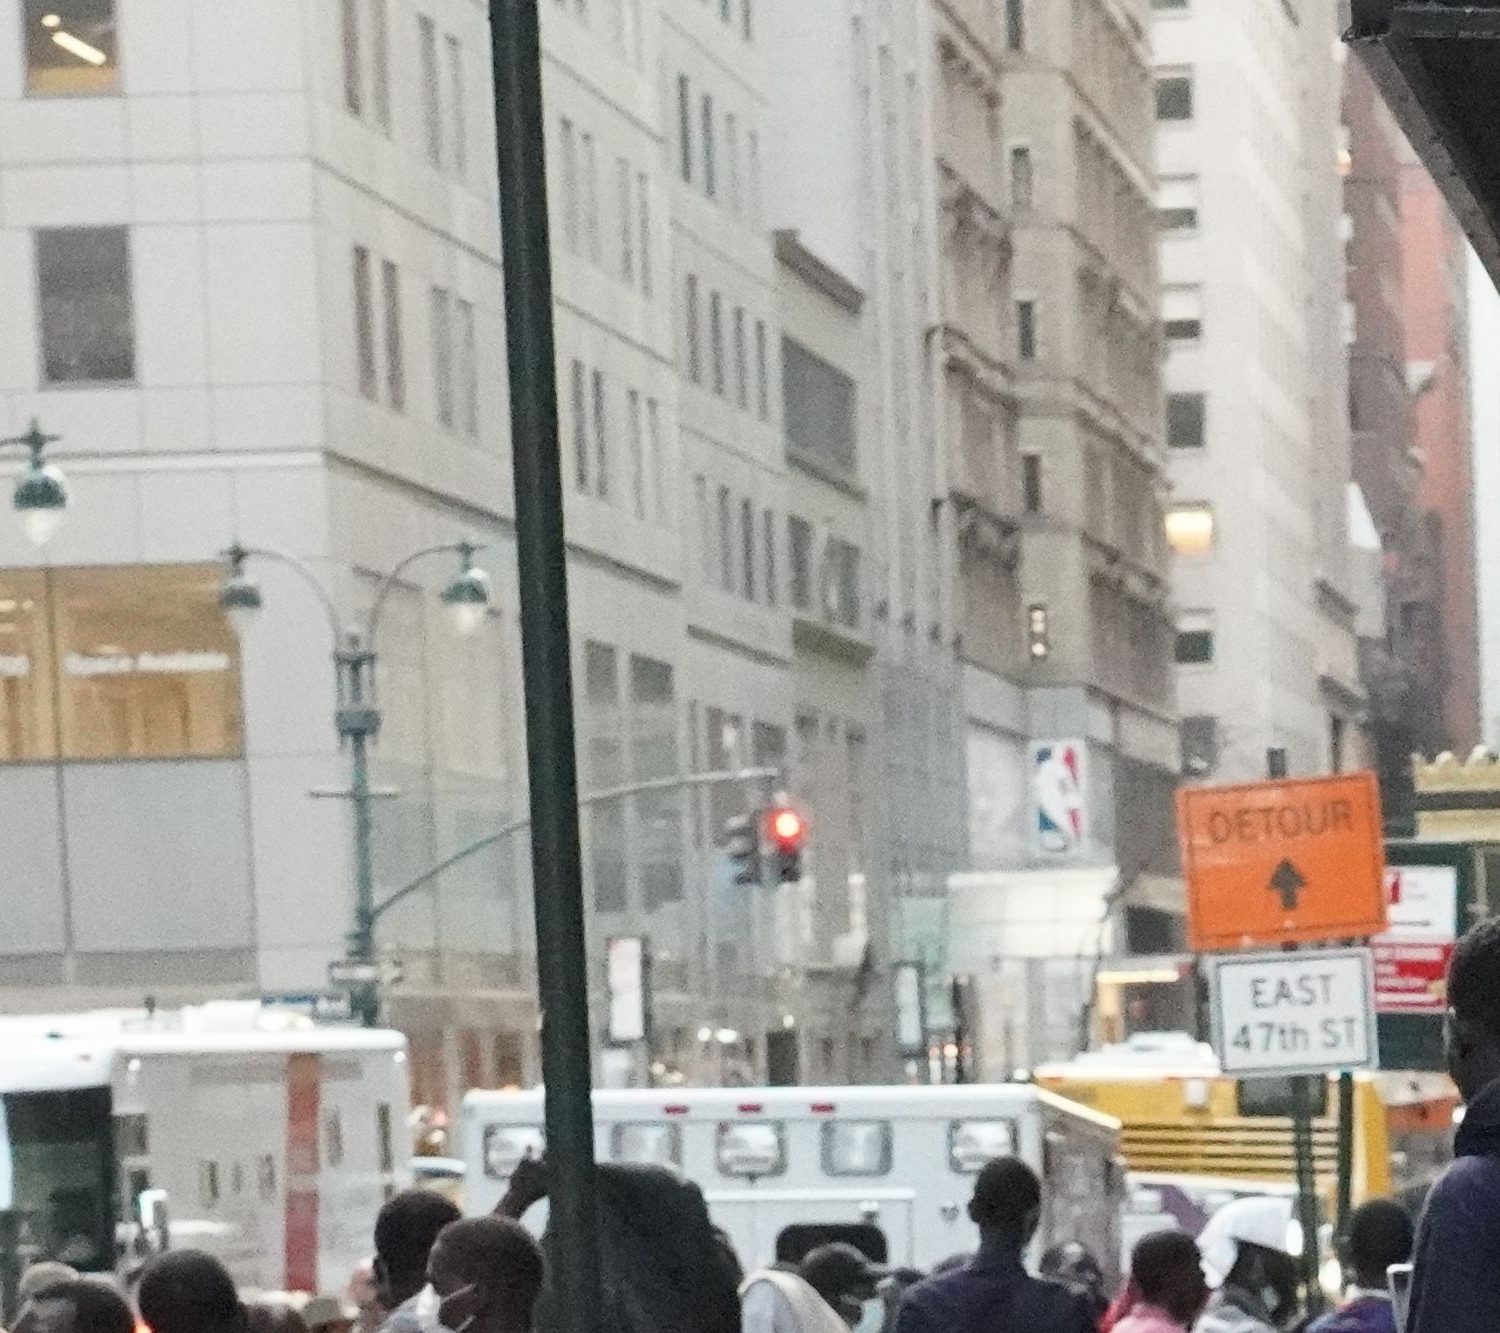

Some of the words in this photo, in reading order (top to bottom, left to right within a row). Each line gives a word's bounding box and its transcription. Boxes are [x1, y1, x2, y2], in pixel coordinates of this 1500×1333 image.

[1208, 797, 1355, 845] DETOUR
[1249, 972, 1334, 1010] EAST
[1231, 1020, 1309, 1055] 47th
[1321, 1017, 1358, 1050] ST
